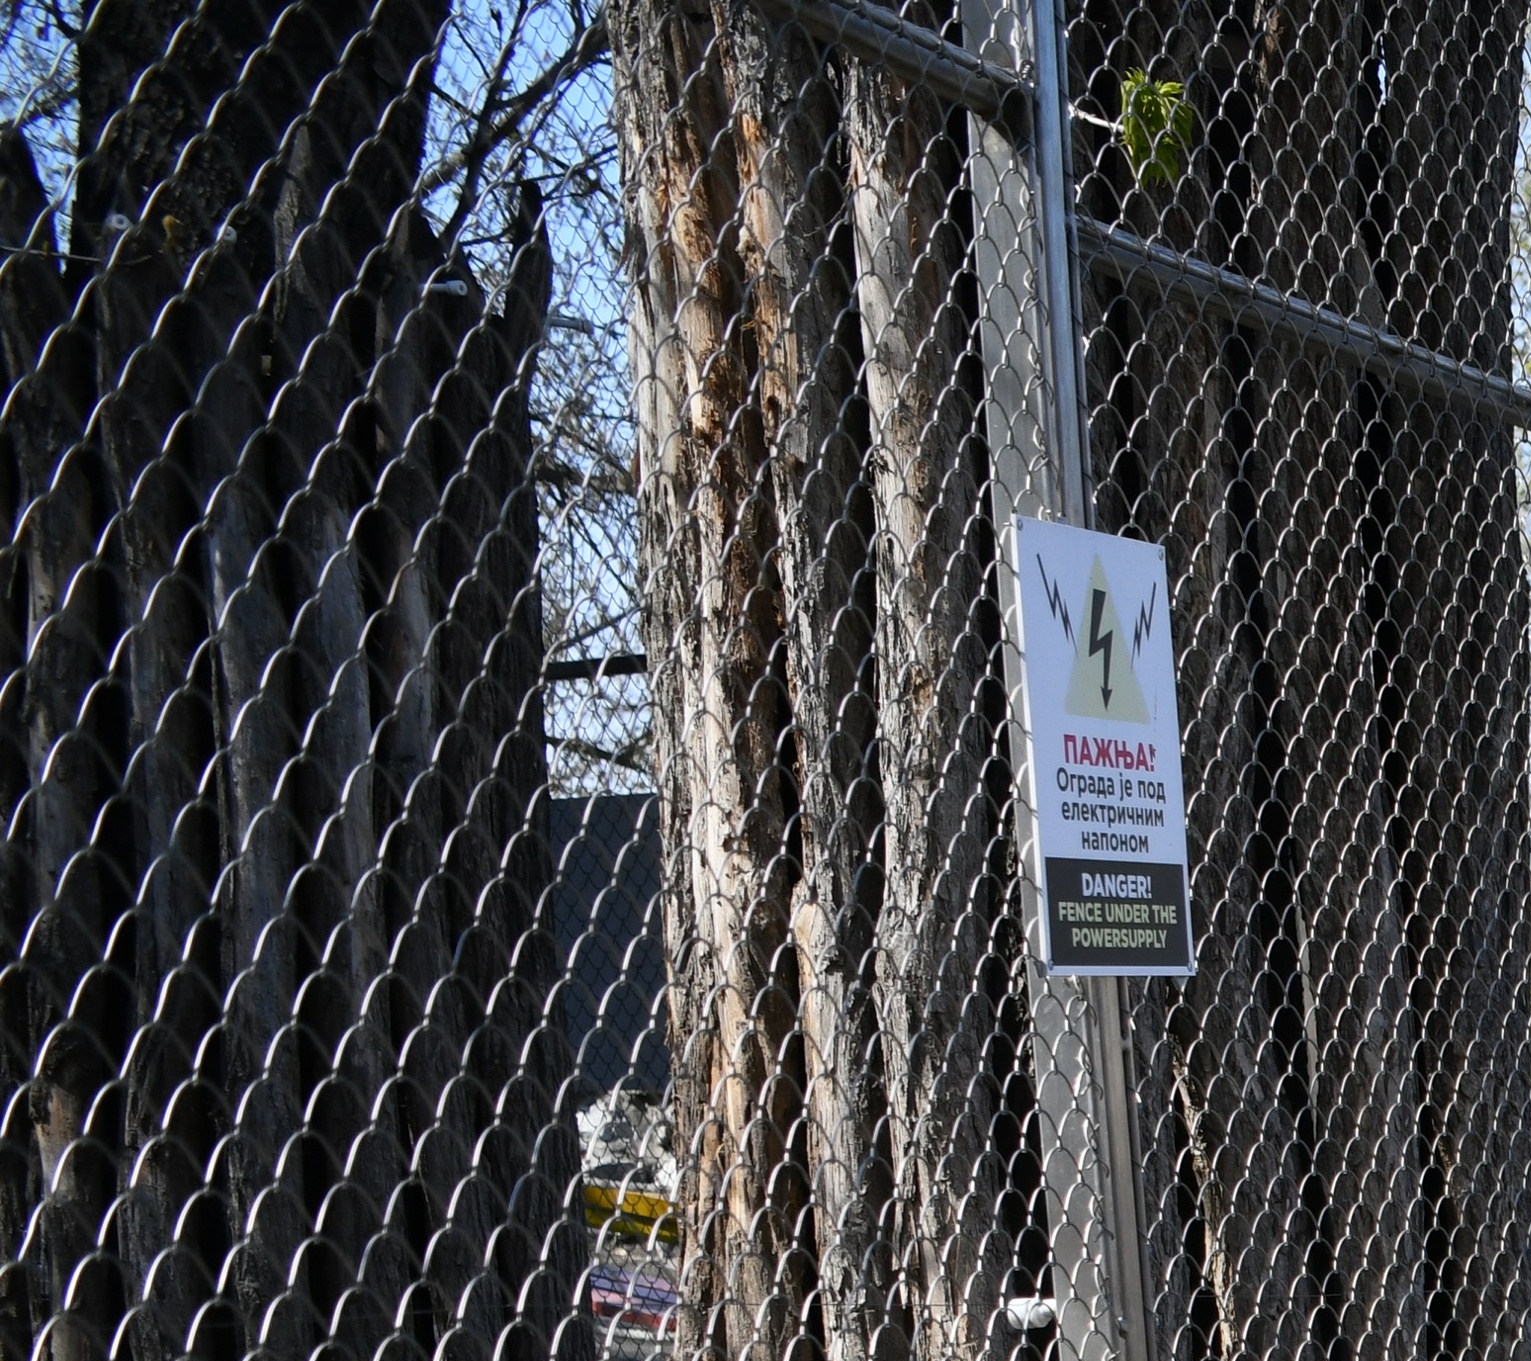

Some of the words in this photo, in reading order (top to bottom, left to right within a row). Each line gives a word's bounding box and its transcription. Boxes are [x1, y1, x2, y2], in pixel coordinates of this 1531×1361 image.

[1063, 734, 1156, 772] ПАЖЊА!
[1056, 767, 1115, 799] Ограда
[1119, 773, 1133, 802] је
[1138, 781, 1166, 804] под
[1061, 801, 1164, 828] електричним
[1081, 831, 1149, 853] напоном
[1081, 872, 1152, 899] DANGER!
[1058, 901, 1102, 922] FENCE
[1105, 904, 1149, 923] UNDER
[1153, 905, 1177, 924] THE
[1072, 928, 1167, 948] POWERSUPPLY
